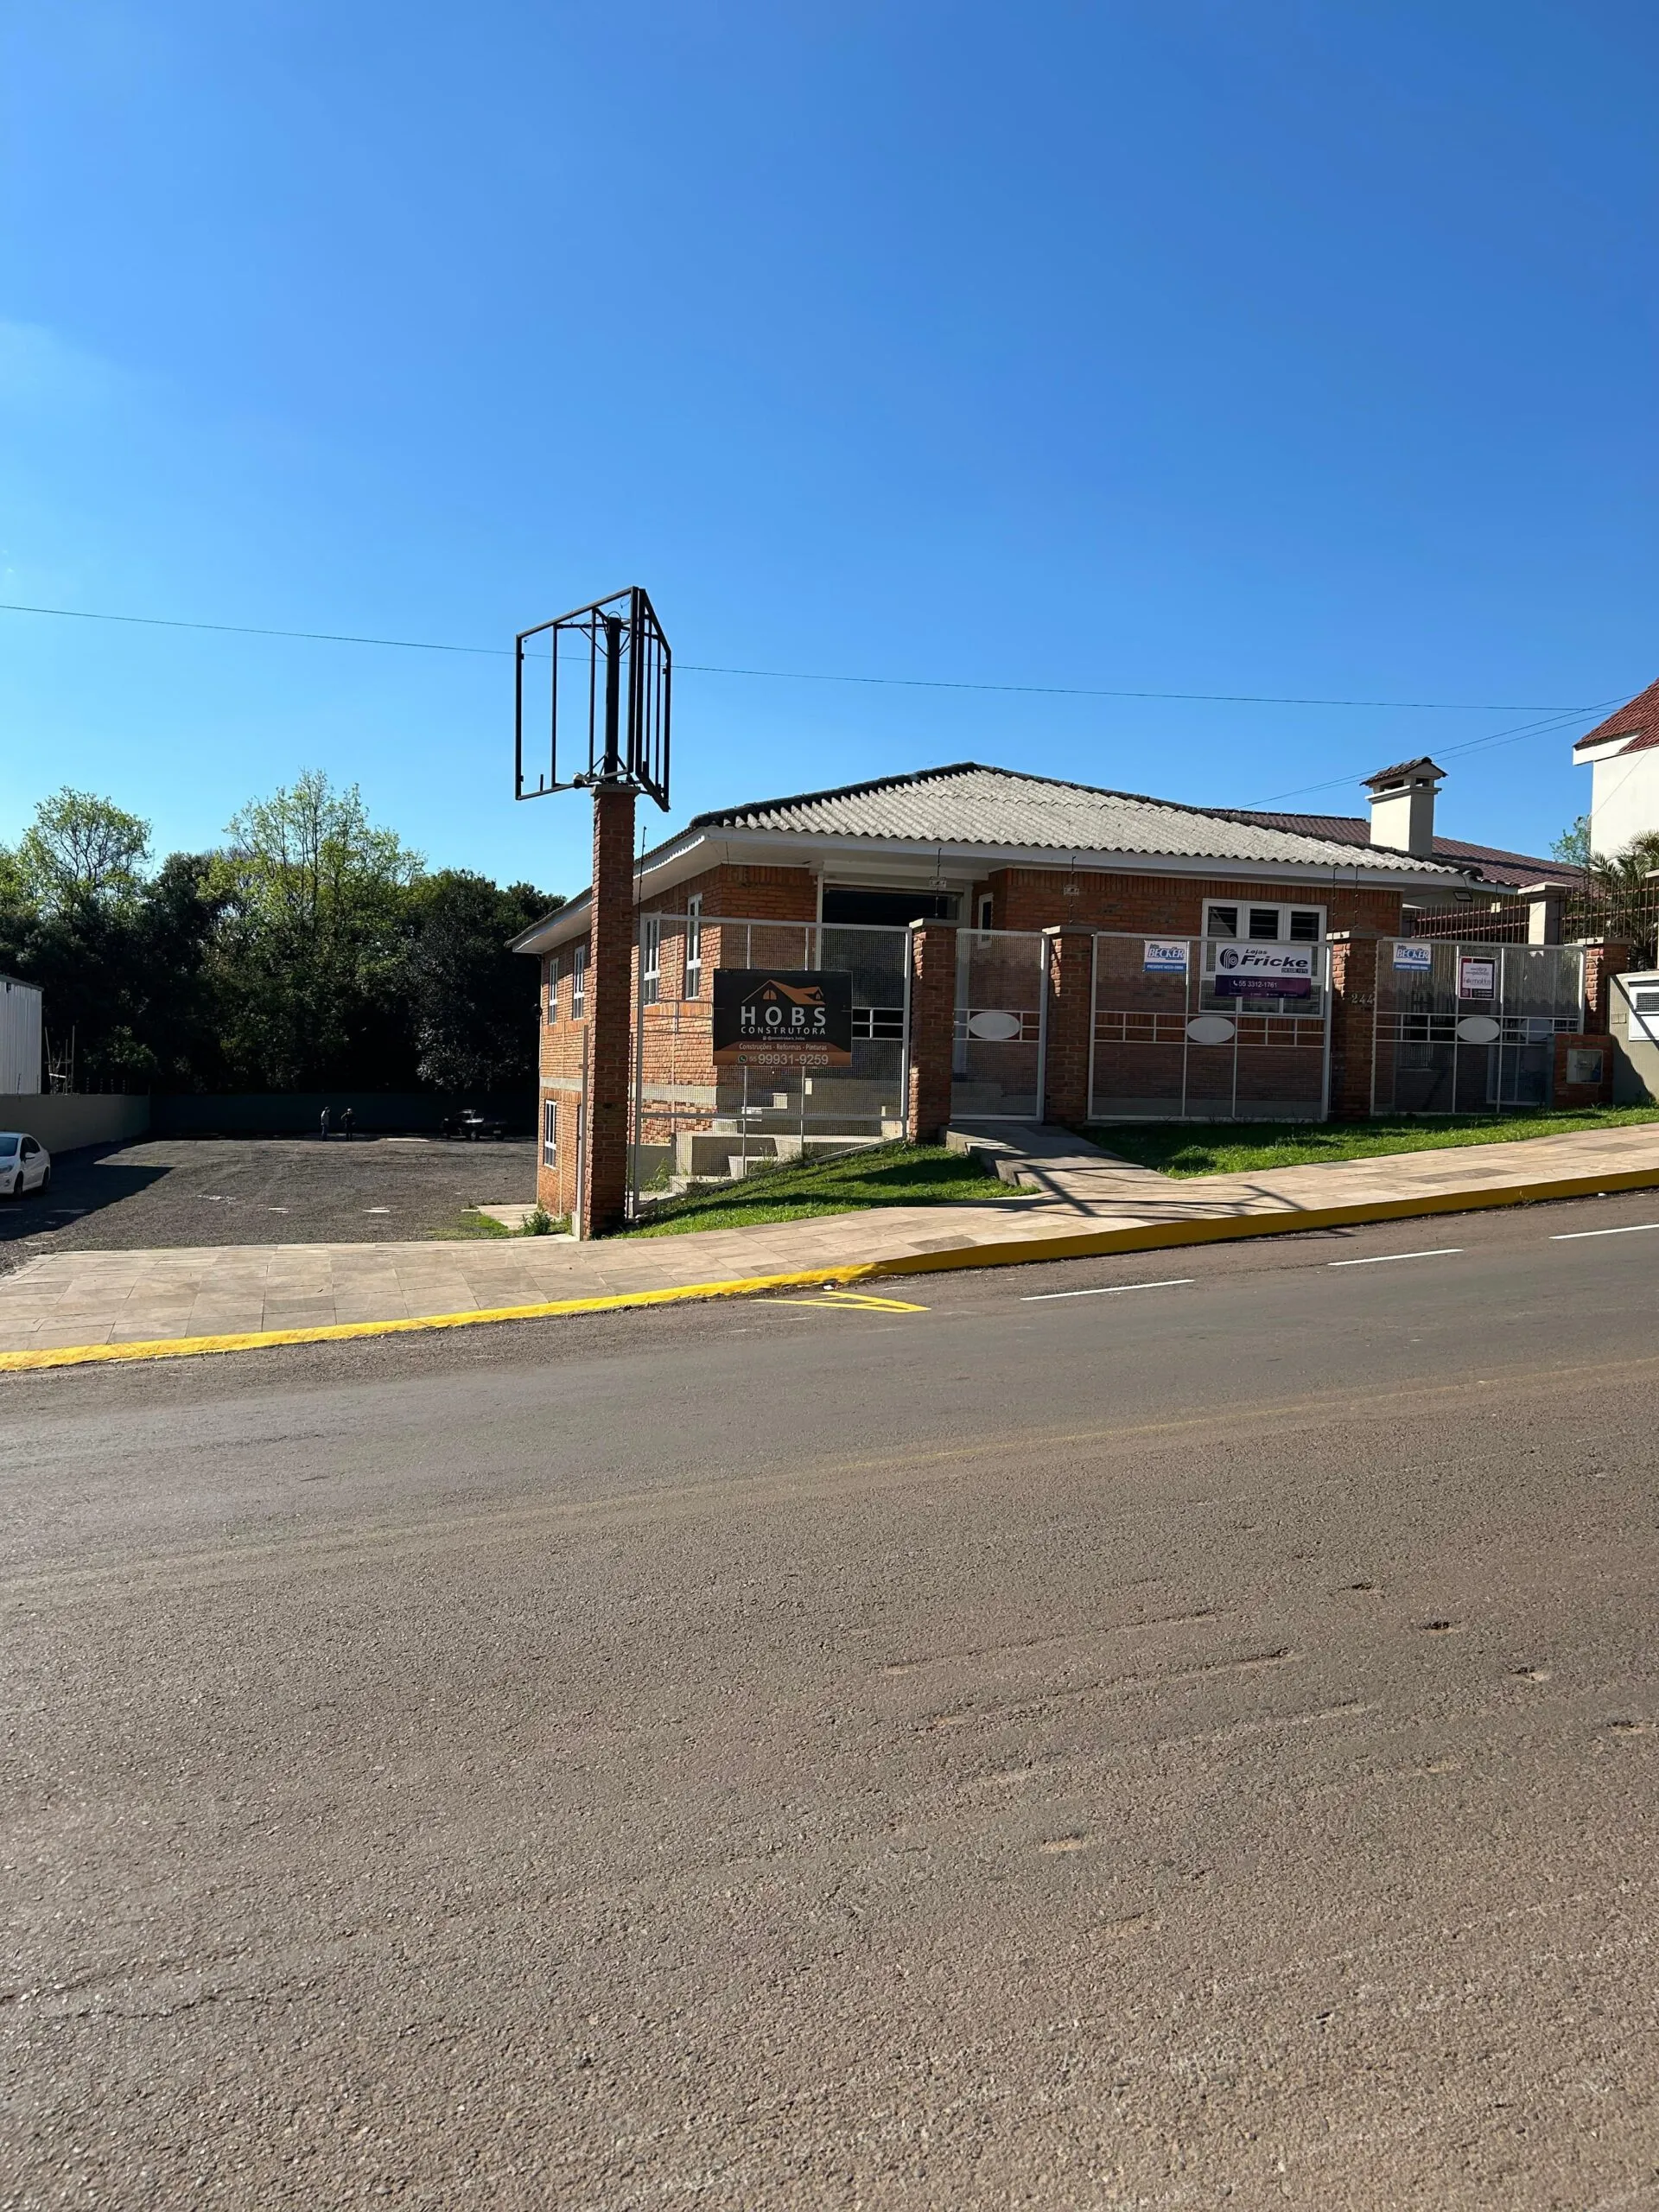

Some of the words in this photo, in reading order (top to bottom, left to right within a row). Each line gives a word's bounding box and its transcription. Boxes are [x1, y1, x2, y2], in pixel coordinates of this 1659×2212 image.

[1147, 947, 1184, 958] BECKER
[1397, 949, 1429, 959] BECKER
[1241, 955, 1308, 968] Fricke
[741, 1006, 826, 1027] HOBS
[741, 1027, 826, 1035] CONSTRUTORA
[758, 1053, 829, 1065] 99931-9259
